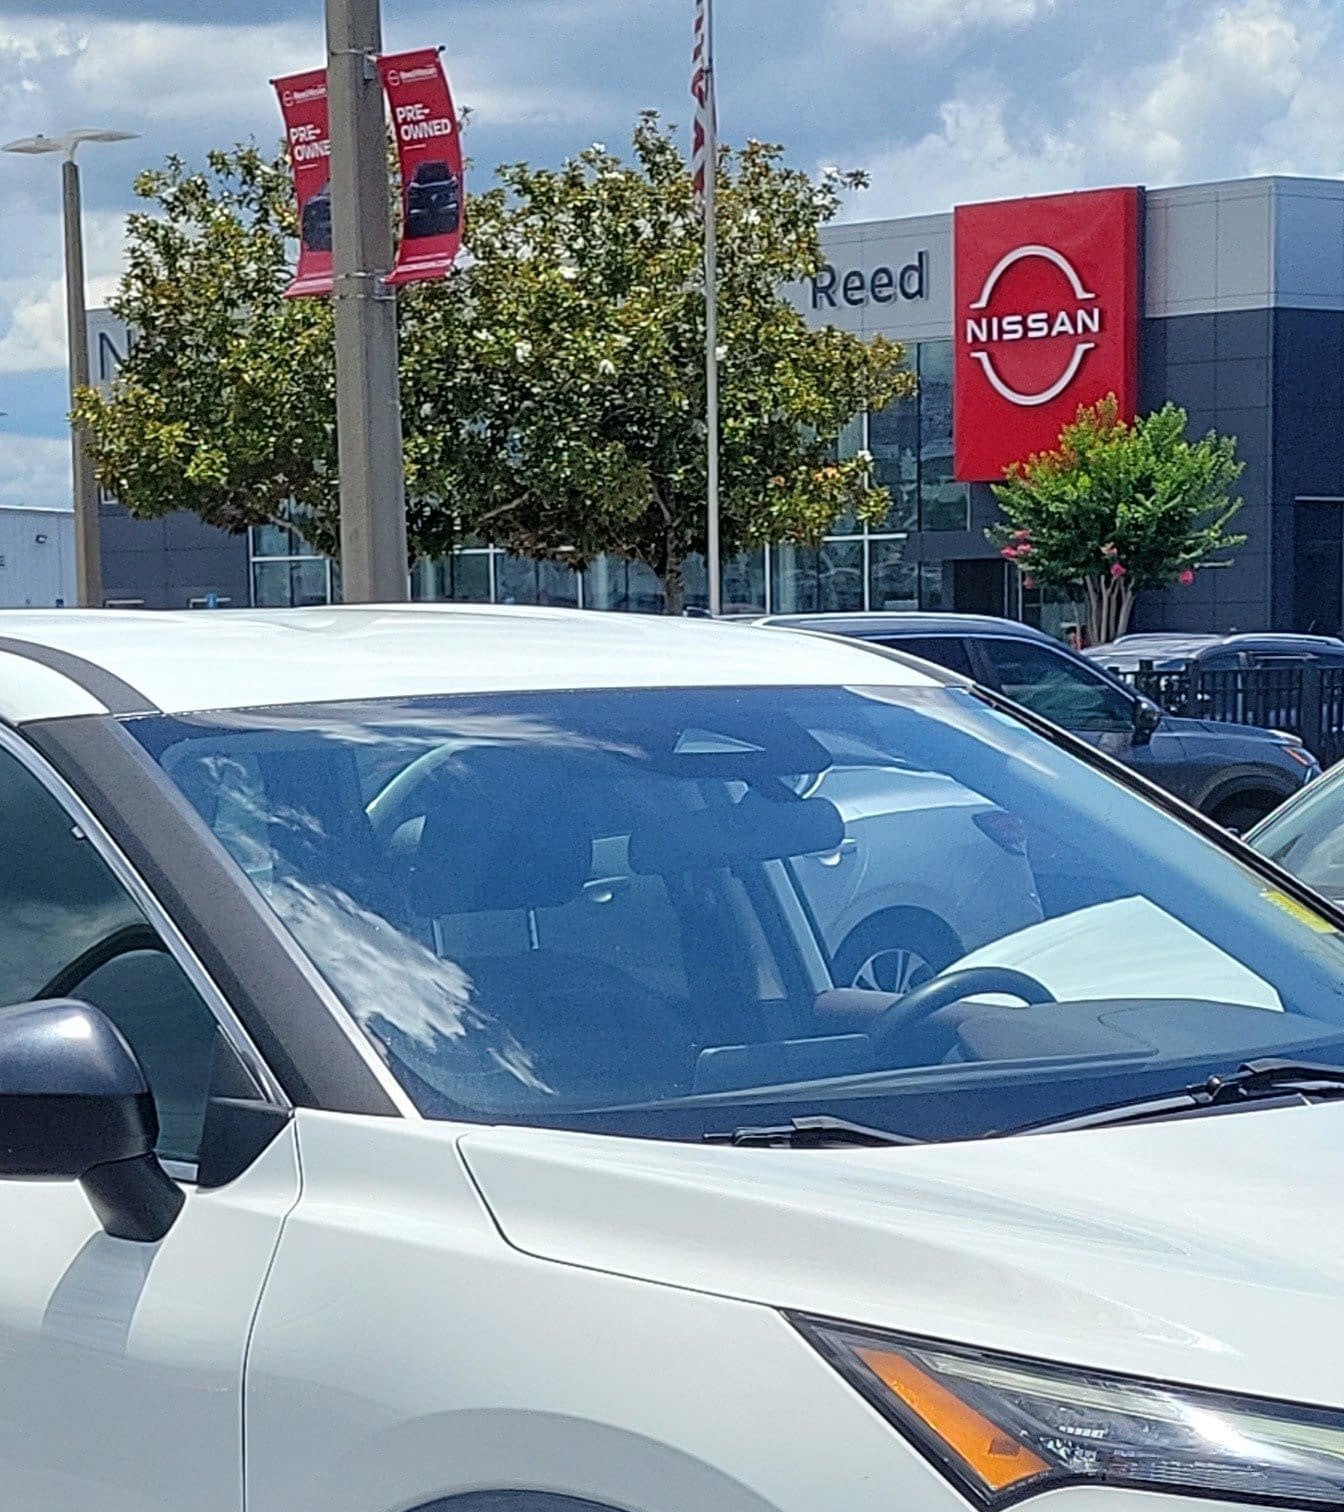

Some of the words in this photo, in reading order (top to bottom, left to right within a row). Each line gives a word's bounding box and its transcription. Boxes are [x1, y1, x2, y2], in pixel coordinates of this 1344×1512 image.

[396, 103, 430, 124] PRE-
[289, 124, 321, 145] PRE-
[400, 118, 452, 141] OWNED
[293, 139, 331, 161] OWNE
[810, 250, 928, 310] Reed
[965, 307, 1101, 345] NISSAN
